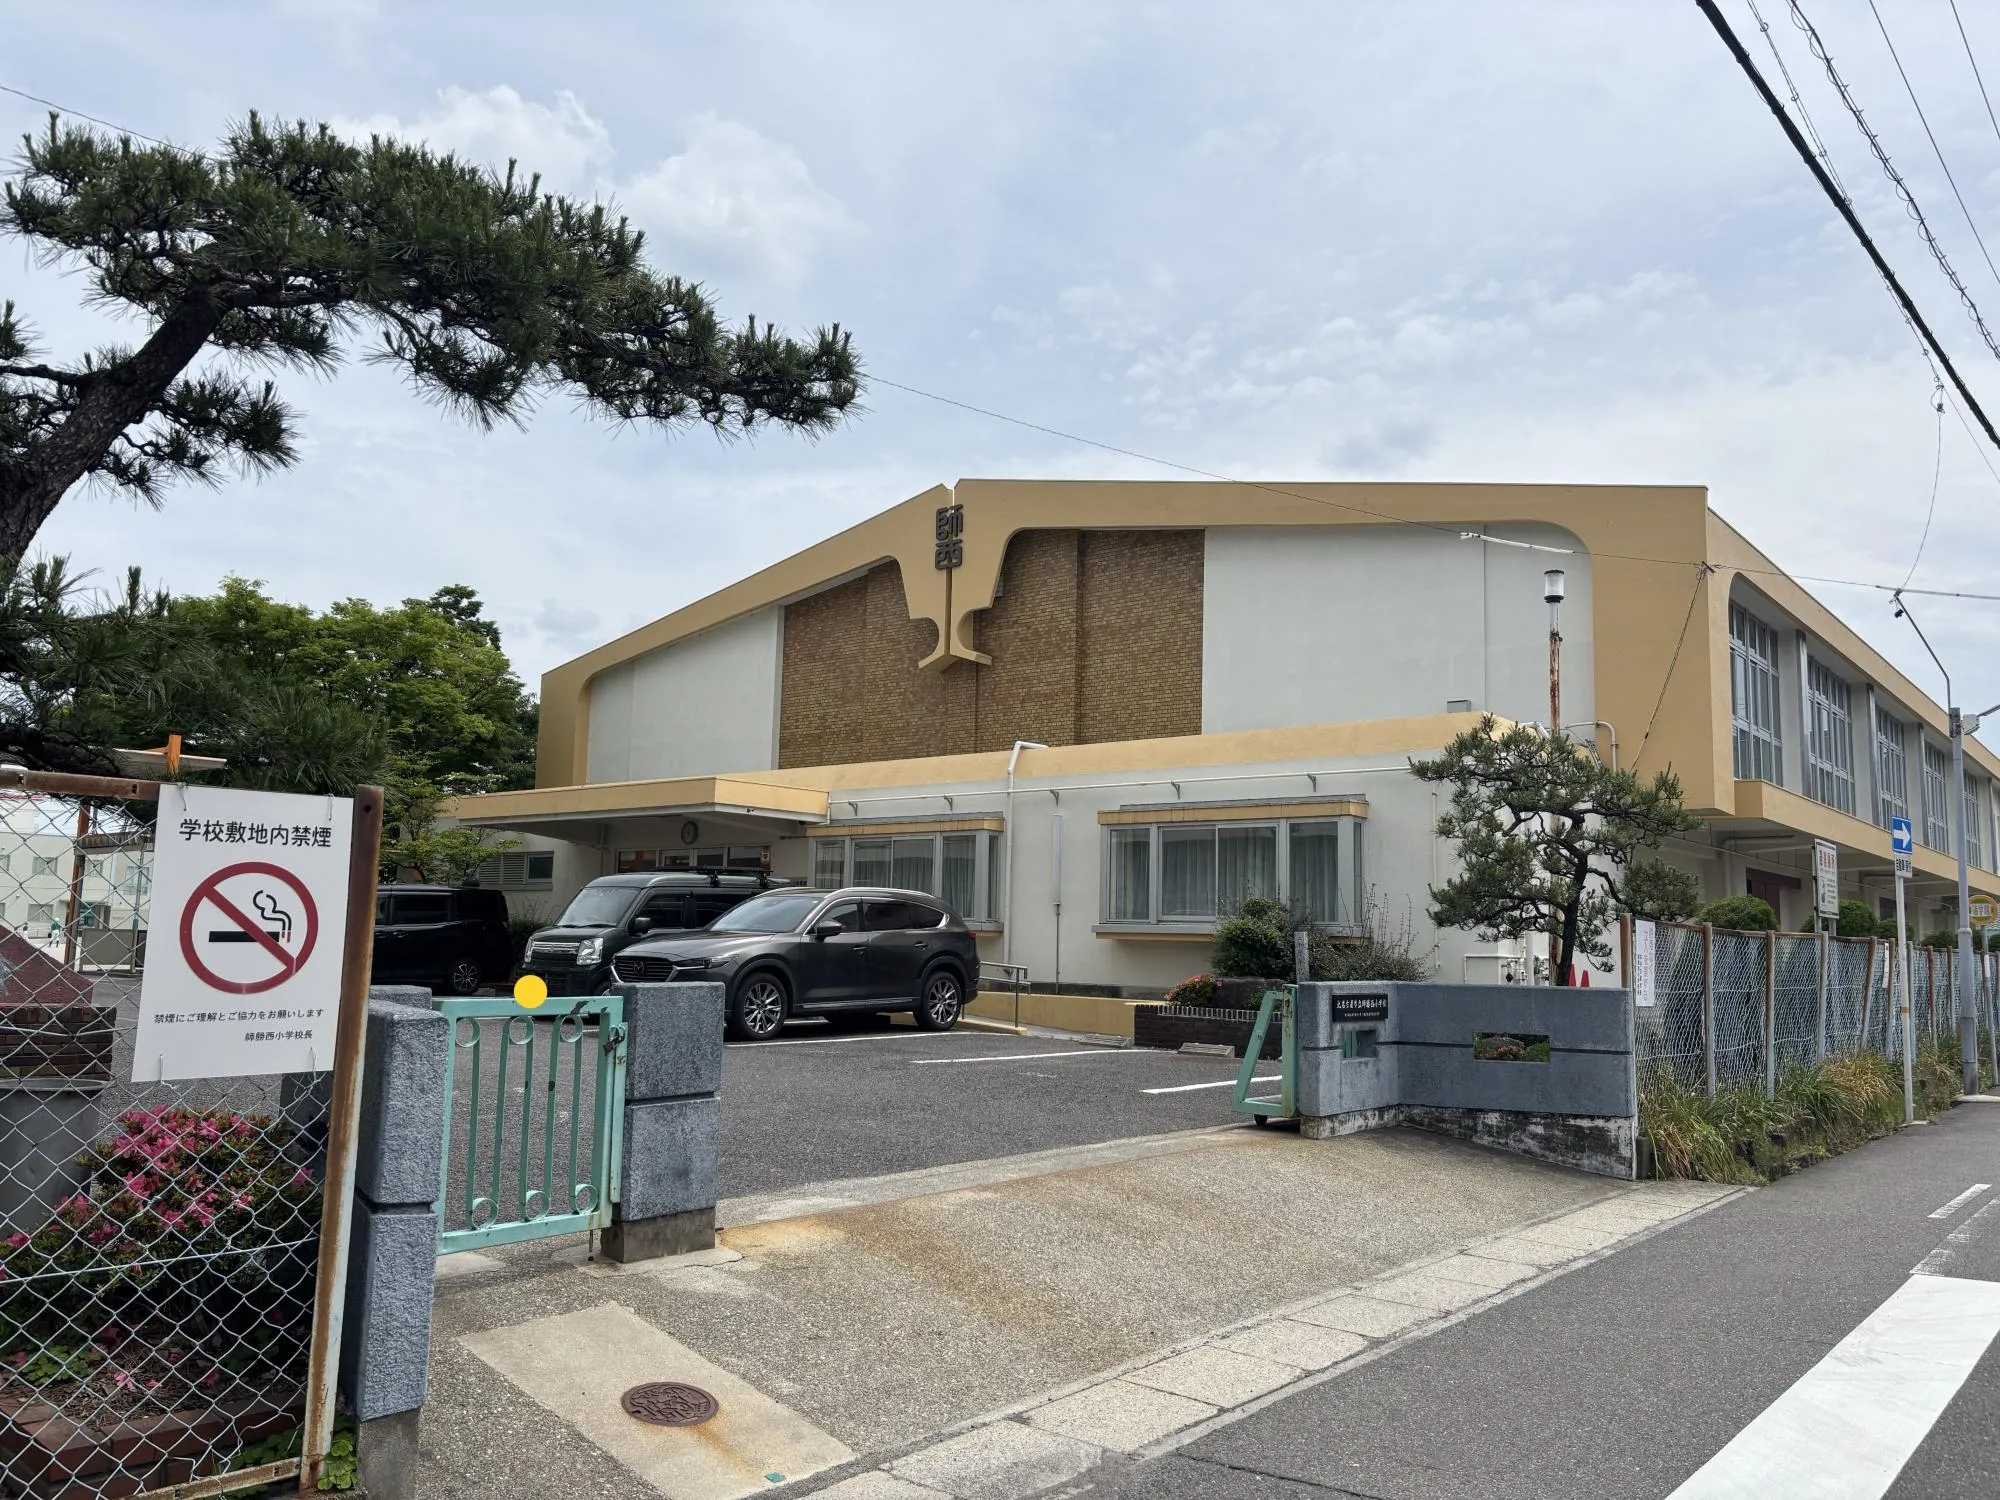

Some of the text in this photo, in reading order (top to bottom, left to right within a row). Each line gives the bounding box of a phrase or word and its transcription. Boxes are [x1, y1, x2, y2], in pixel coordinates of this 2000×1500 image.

[178, 818, 333, 848] 学校敷地内禁煙
[153, 1007, 325, 1025] 禁煙にご理解とご協力をお願いします
[244, 1029, 313, 1042] 師勝西小学校長
